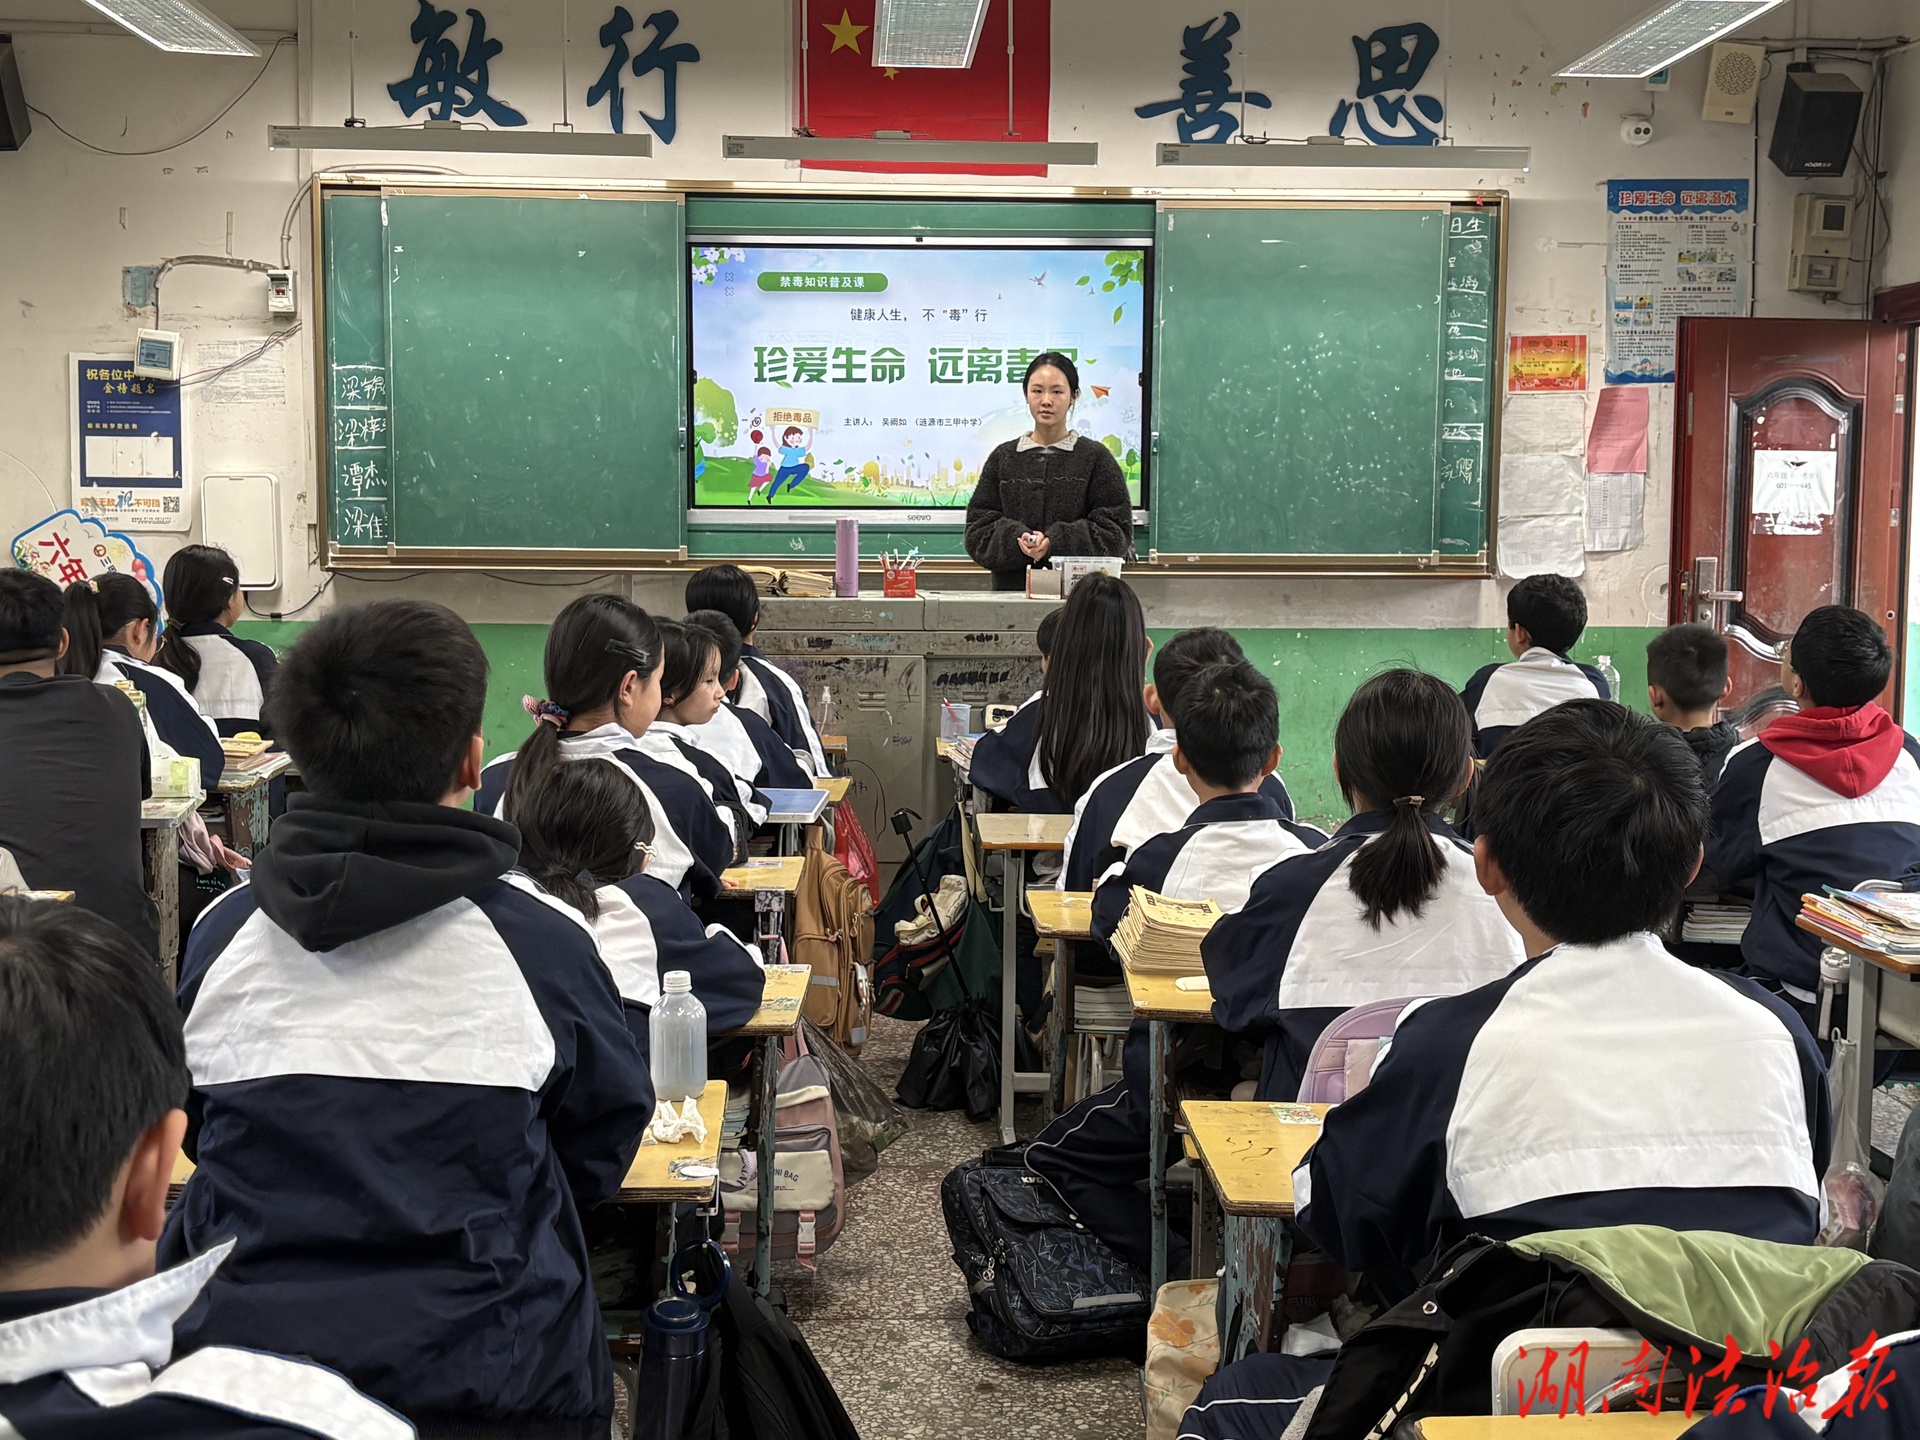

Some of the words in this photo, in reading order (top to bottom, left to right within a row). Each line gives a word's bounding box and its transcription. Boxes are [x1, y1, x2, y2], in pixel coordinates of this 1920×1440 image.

[1619, 190, 1676, 206] 珍爱生命
[1680, 190, 1737, 206] 远离溺水
[780, 276, 865, 289] 禁毒知识普及课
[850, 308, 907, 322] 健康人生，
[753, 346, 906, 384] 珍爱生命
[928, 346, 1078, 384] 远离毒
[103, 382, 155, 395] 金榜题名
[773, 411, 813, 424] 拒绝毒品
[783, 1170, 799, 1182] BAG
